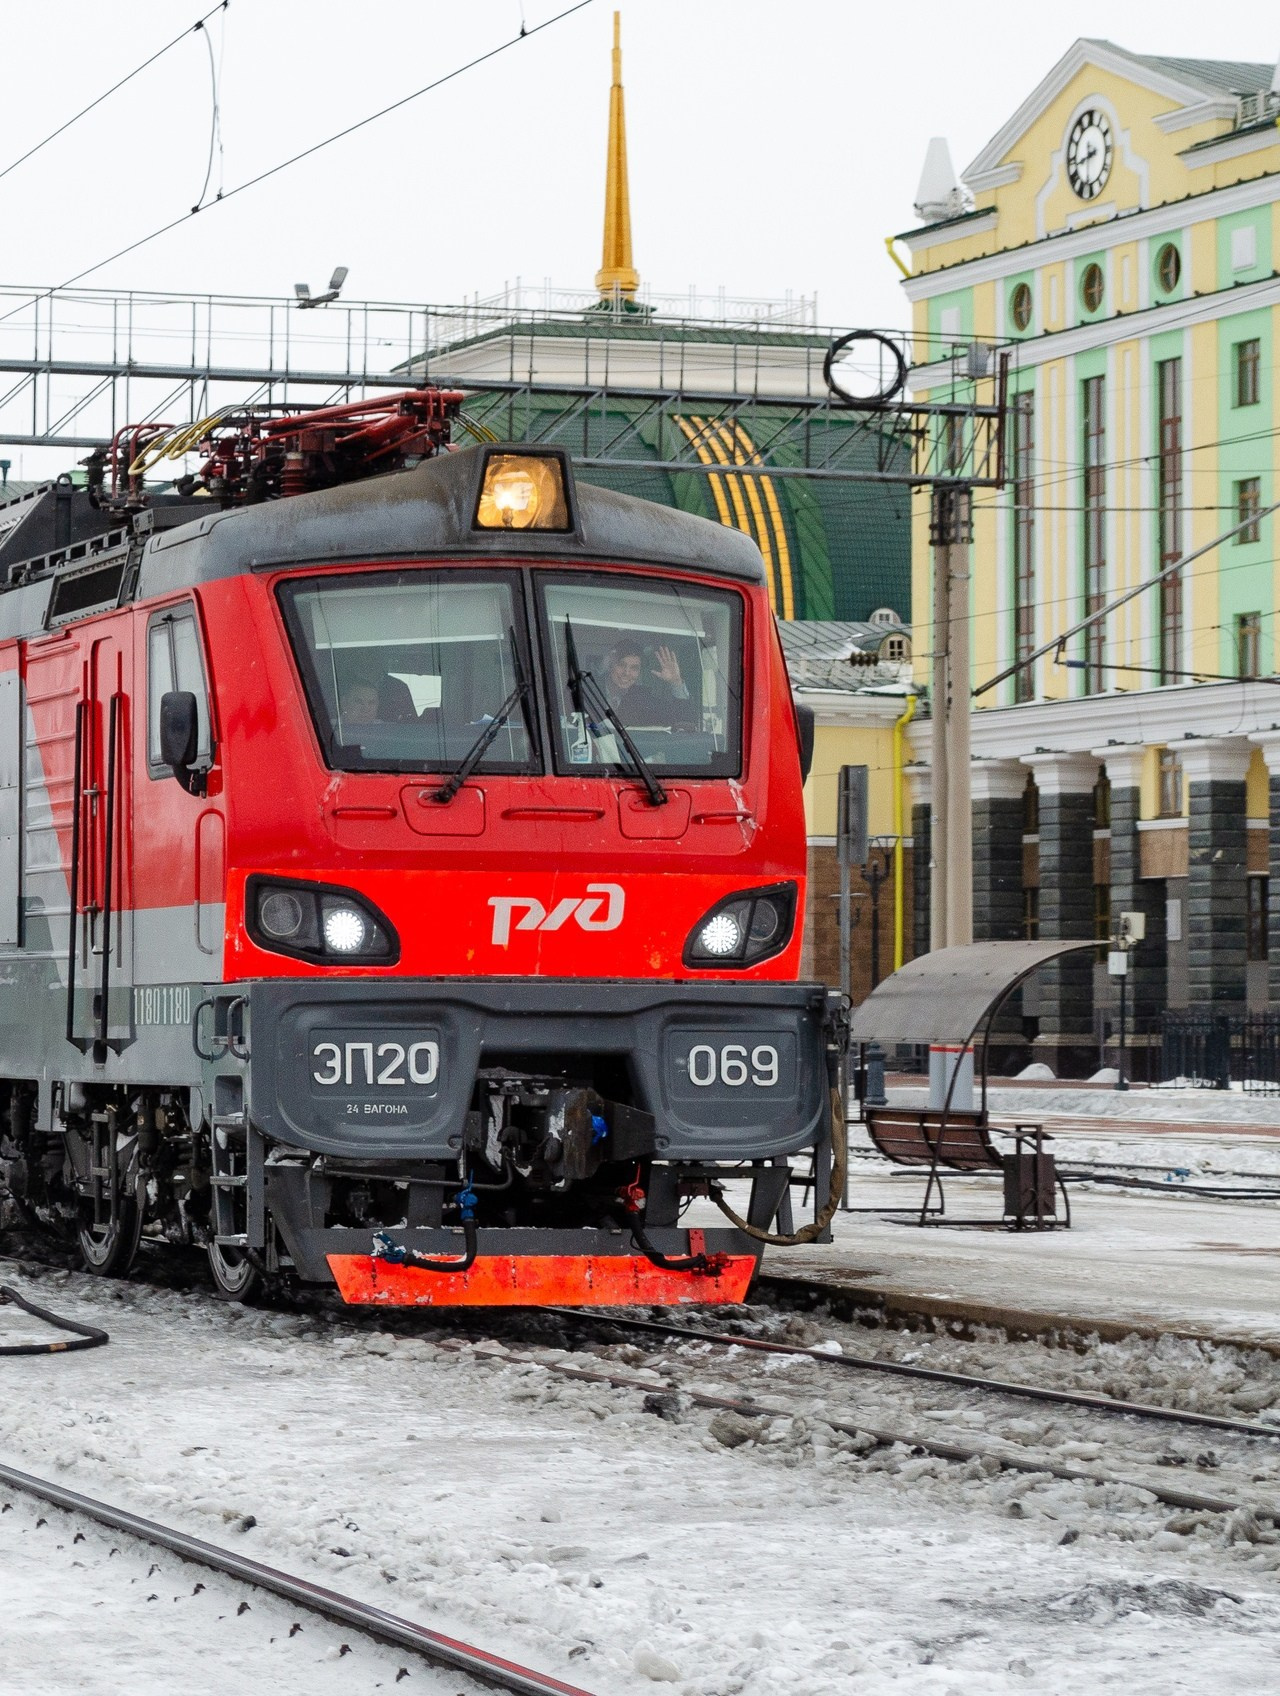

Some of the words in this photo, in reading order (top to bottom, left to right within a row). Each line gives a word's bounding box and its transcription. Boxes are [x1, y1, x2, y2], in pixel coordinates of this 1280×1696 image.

[134, 986, 191, 1025] 11801180
[313, 1040, 440, 1086] ЭП20
[687, 1043, 780, 1087] 069
[346, 1104, 359, 1114] 24
[364, 1104, 409, 1114] ВАГОНА
